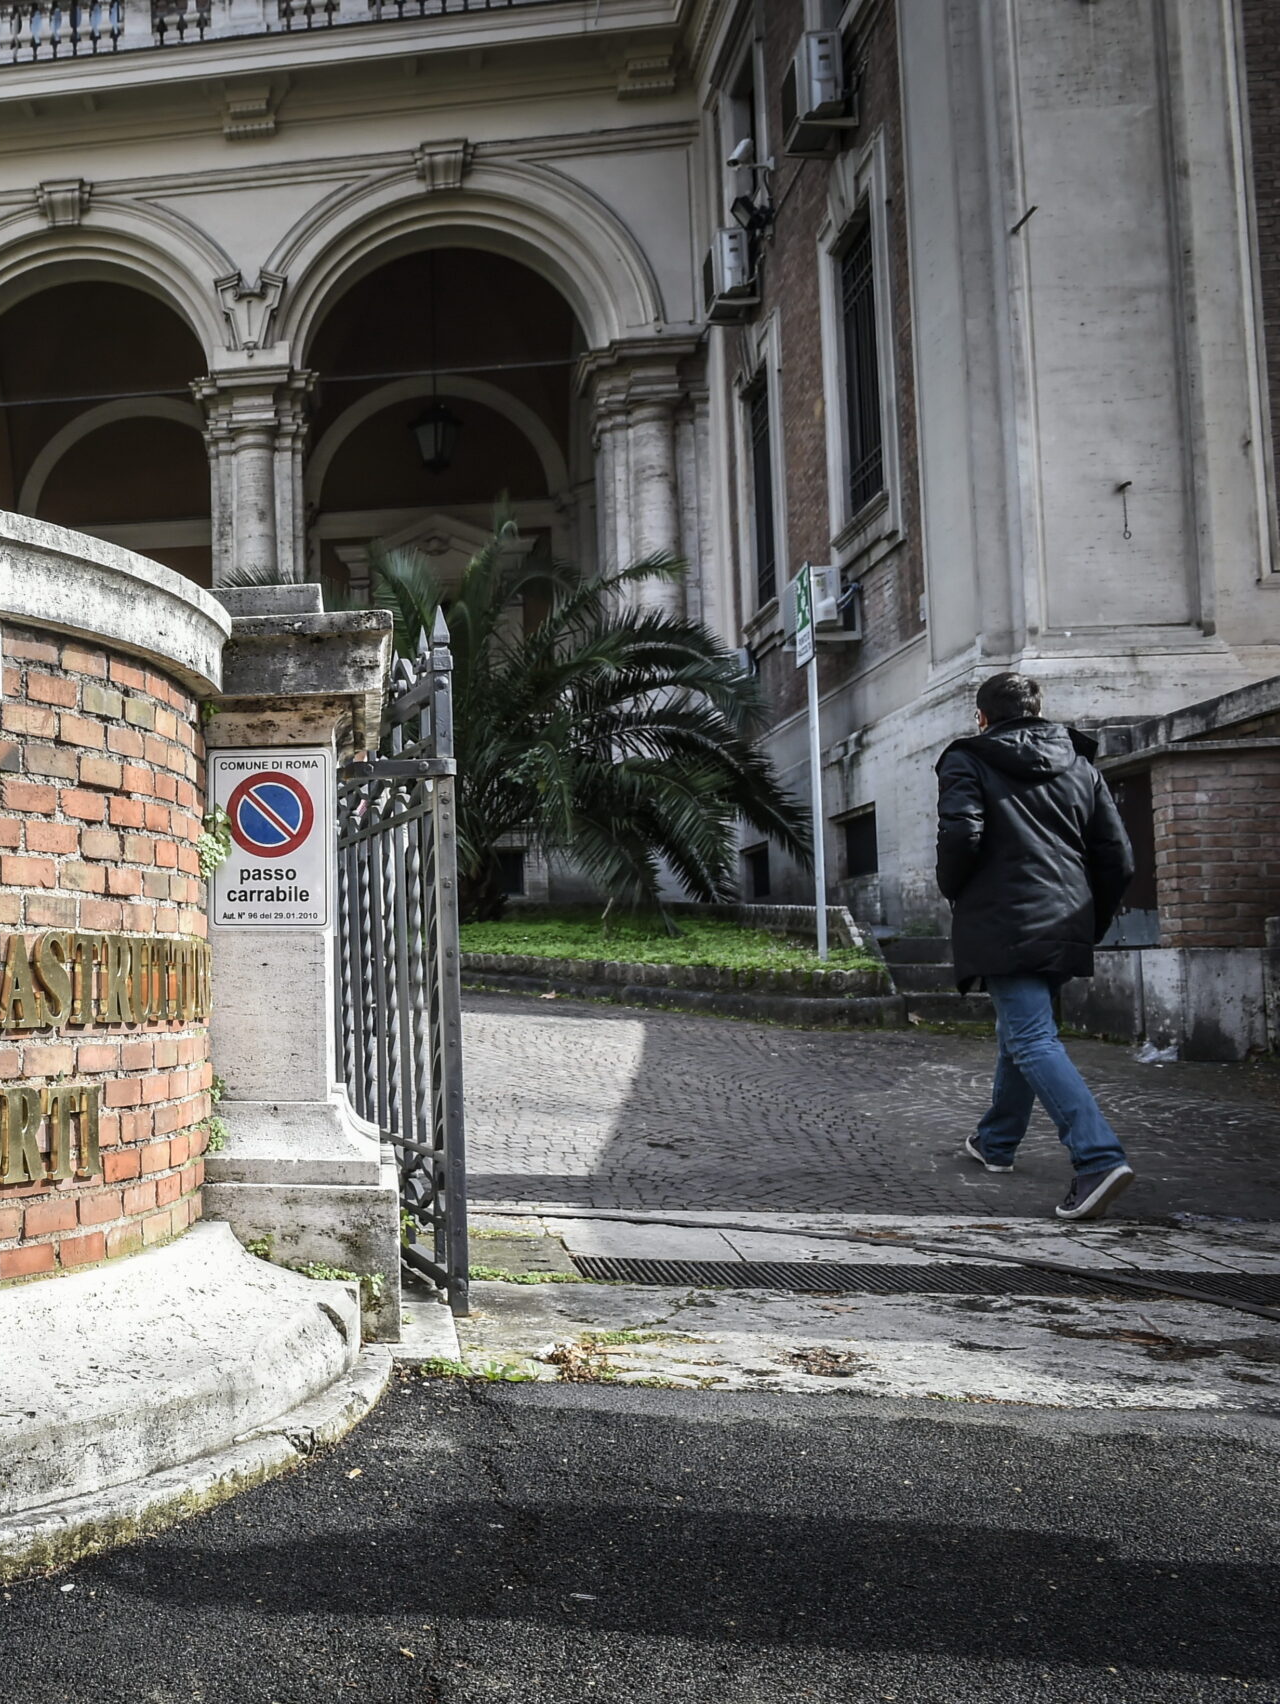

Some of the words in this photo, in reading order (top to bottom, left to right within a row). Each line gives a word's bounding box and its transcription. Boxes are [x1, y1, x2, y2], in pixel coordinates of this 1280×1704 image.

[220, 761, 269, 771] COMUNE
[271, 761, 283, 770] DI
[285, 760, 319, 769] ROMA
[239, 867, 297, 885] passo
[227, 886, 310, 903] carrabile
[222, 912, 236, 920] Aut.
[247, 912, 258, 920] 96
[259, 912, 272, 920] del
[274, 912, 318, 920] 29.01.2010
